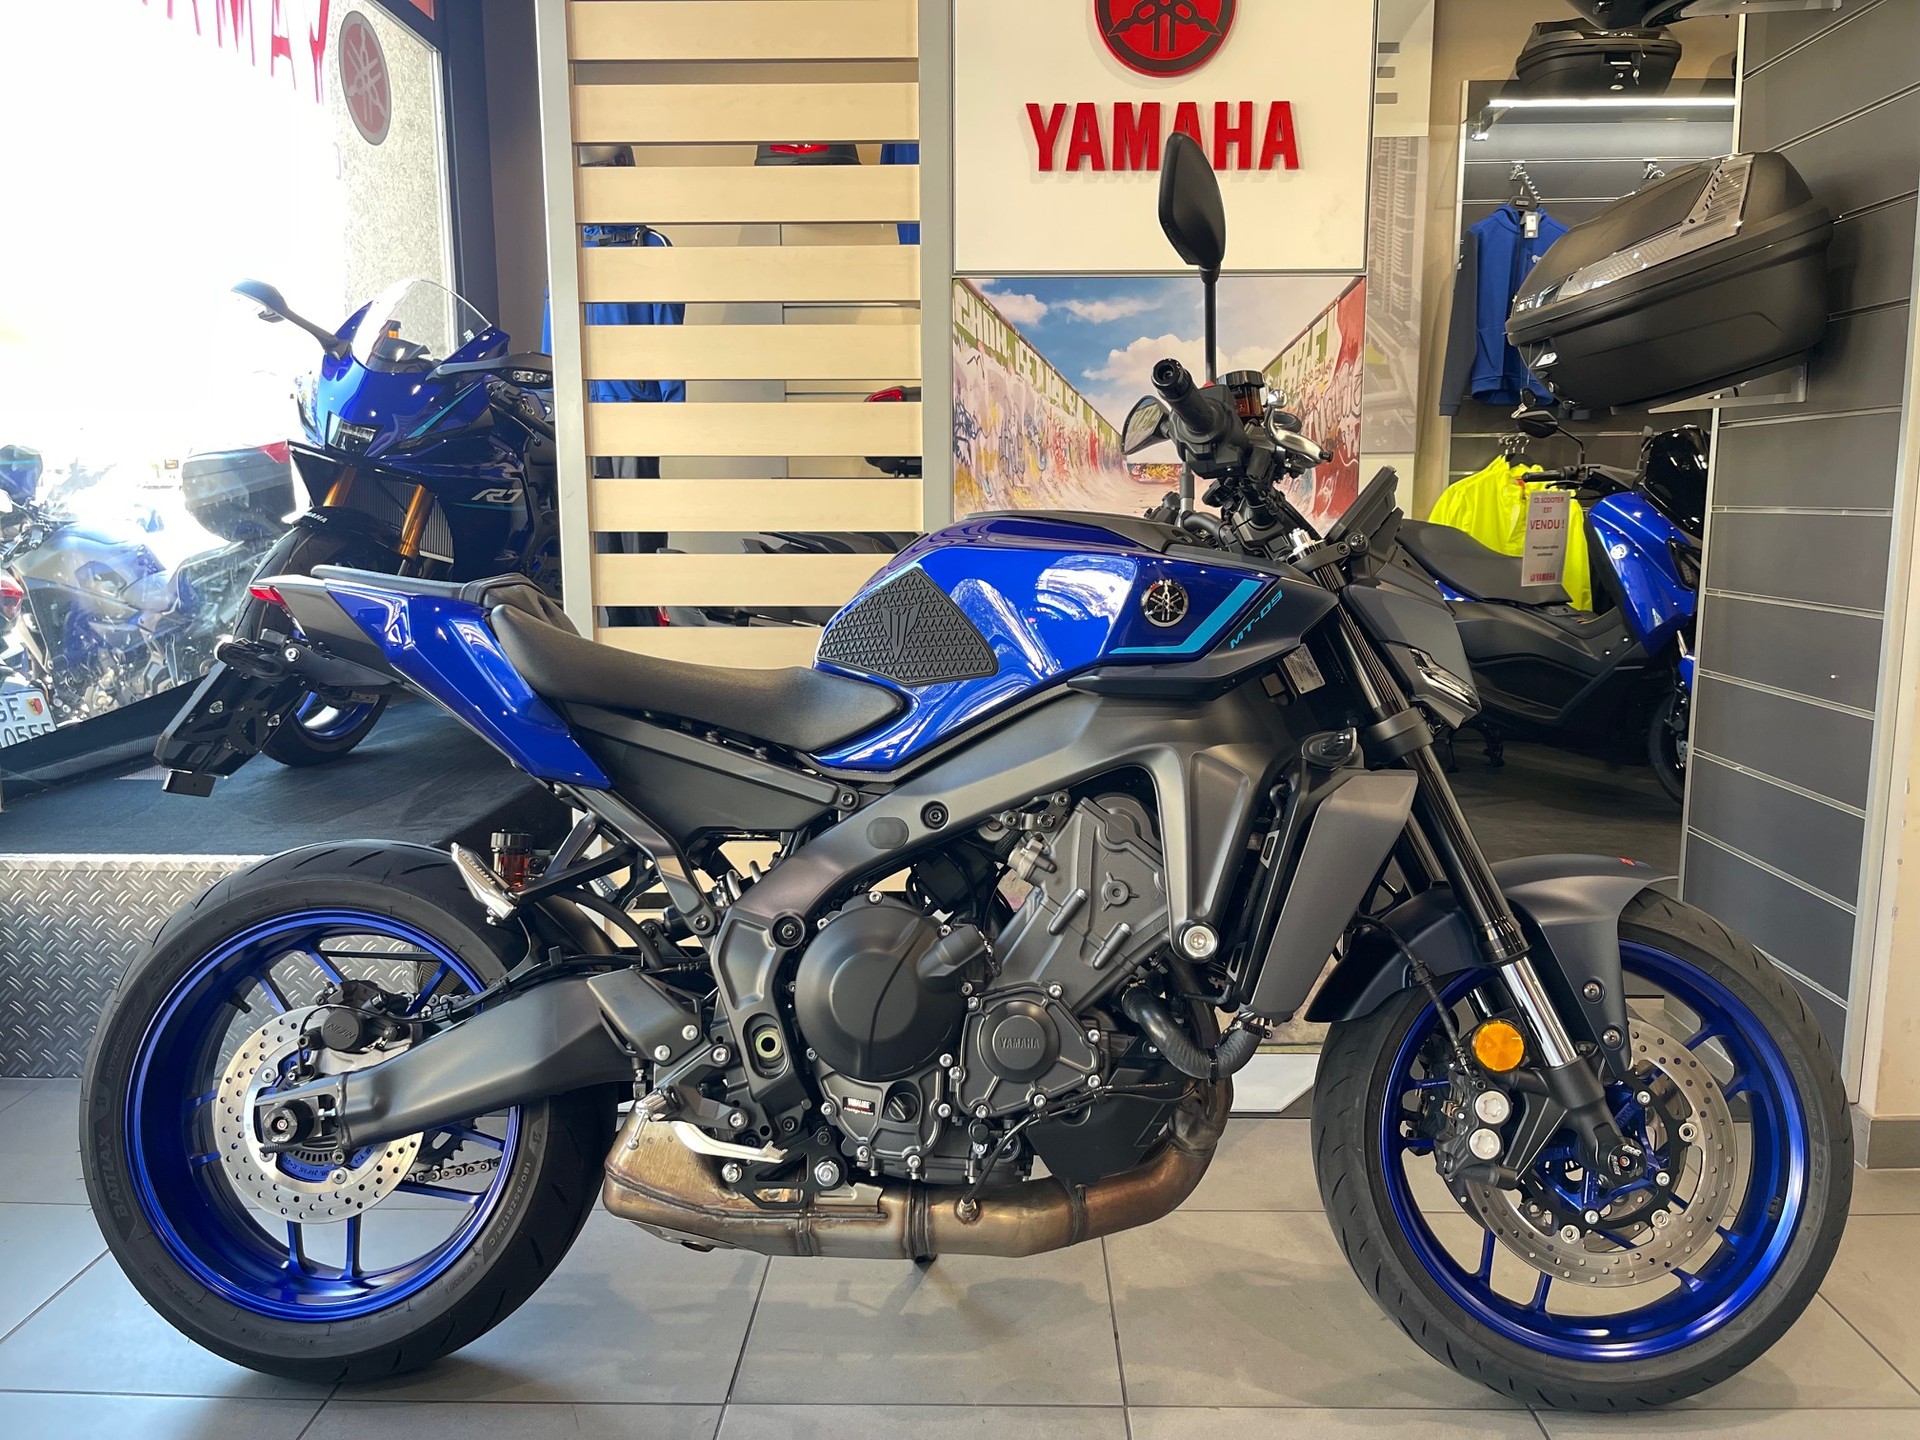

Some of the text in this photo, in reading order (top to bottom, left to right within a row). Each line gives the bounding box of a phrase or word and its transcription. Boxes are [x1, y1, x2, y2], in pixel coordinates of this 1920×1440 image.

[1026, 101, 1300, 172] YAMAHA
[1530, 519, 1560, 530] VENDU
[1229, 589, 1283, 650] MT-09
[1000, 1037, 1040, 1049] YAMAHA
